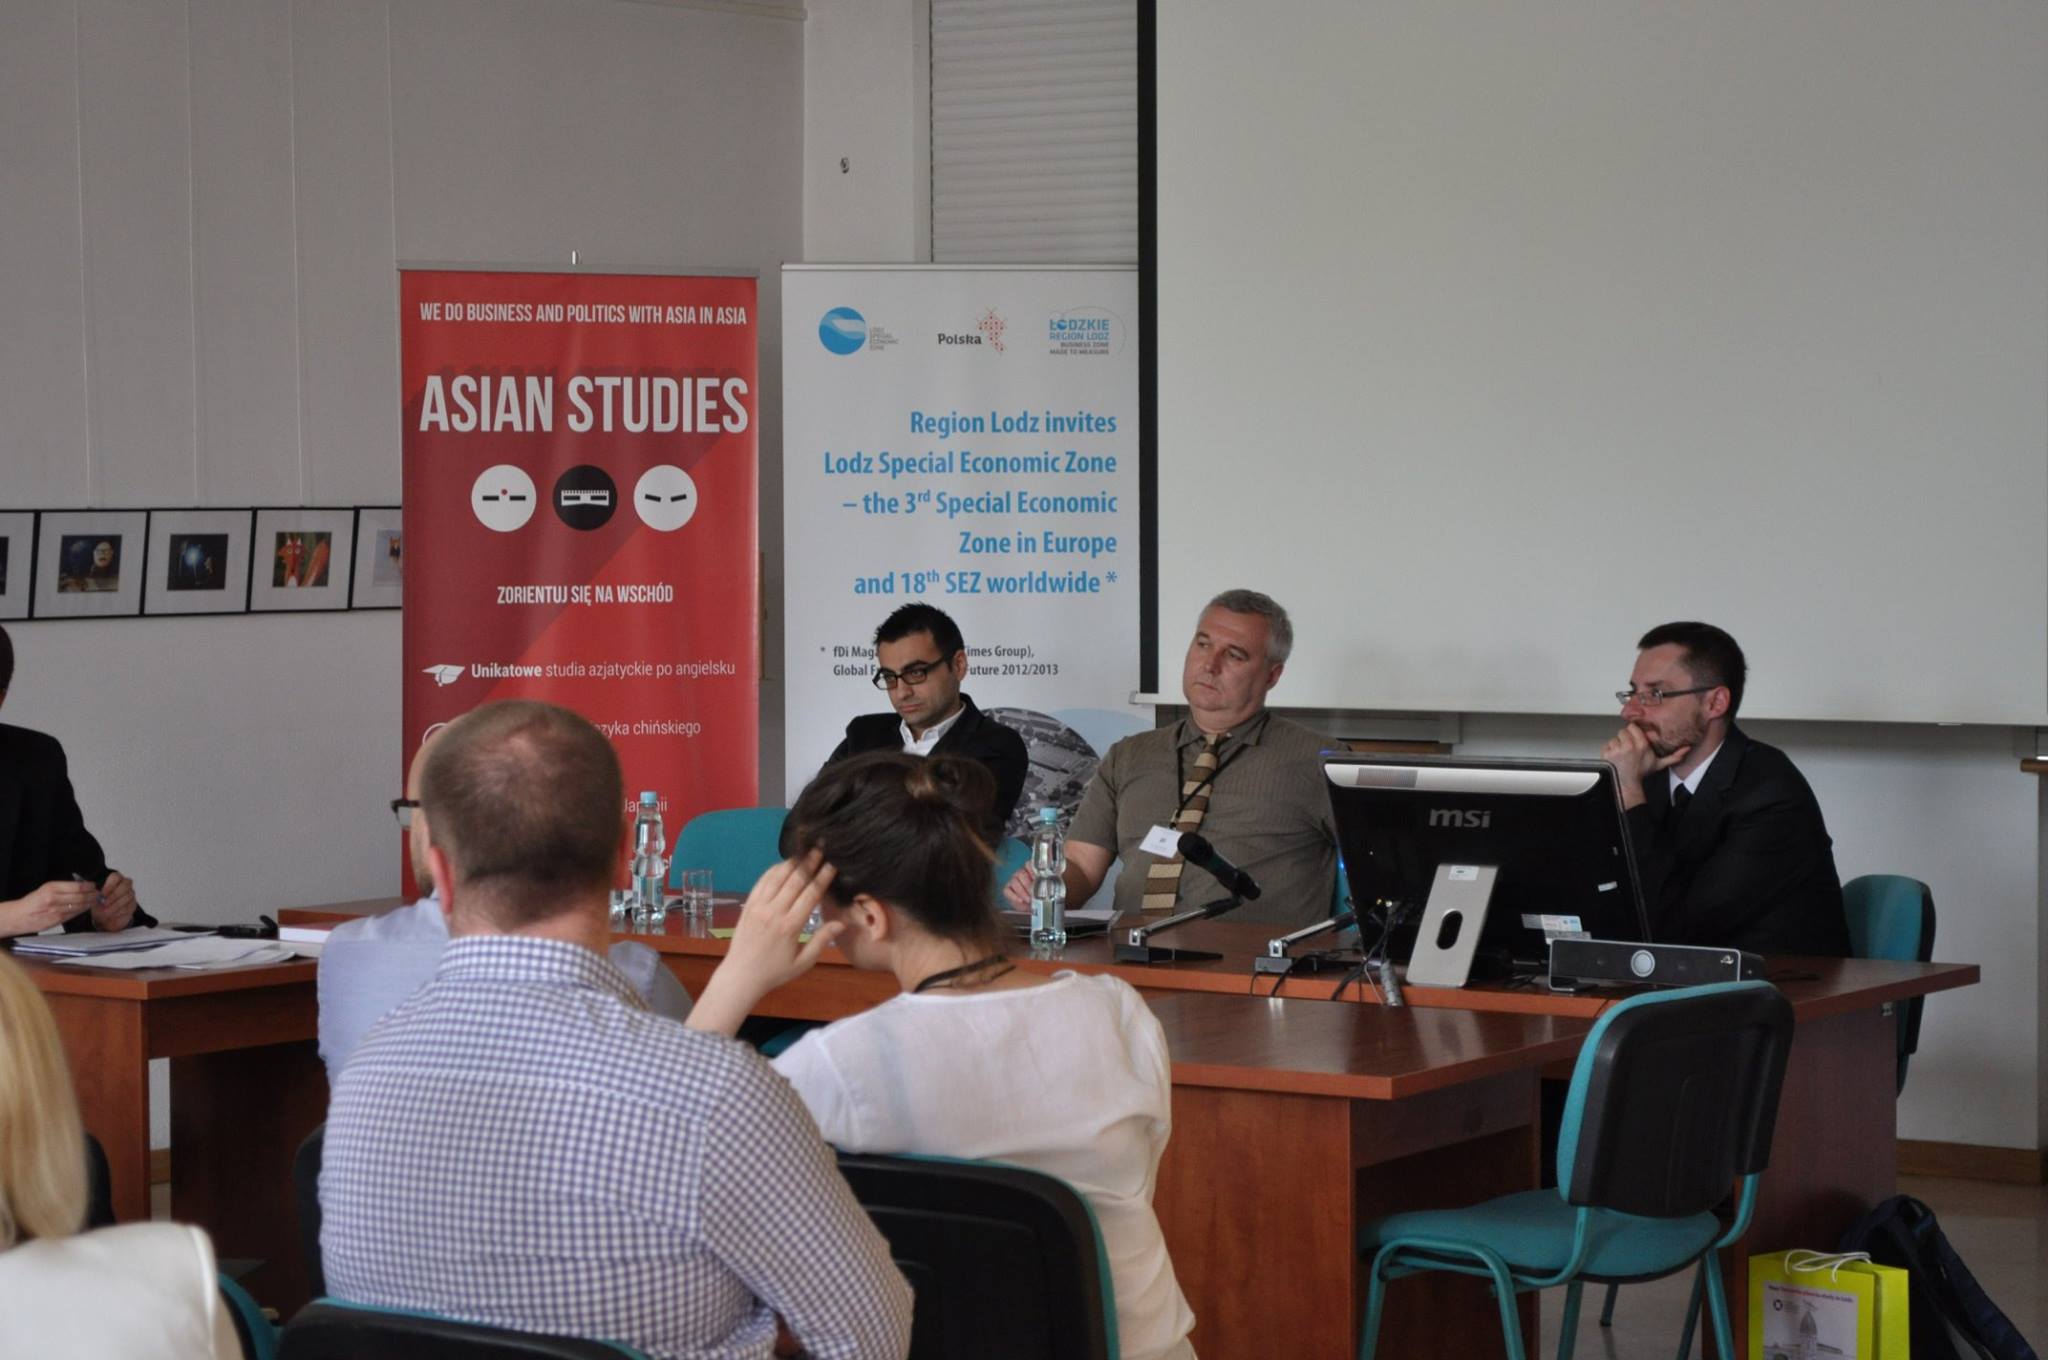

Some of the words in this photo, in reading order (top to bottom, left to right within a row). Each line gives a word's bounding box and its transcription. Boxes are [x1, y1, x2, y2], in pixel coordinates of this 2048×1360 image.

[420, 302, 442, 321] WE
[445, 303, 463, 321] DO
[467, 303, 532, 322] BUSINESS
[536, 304, 563, 322] AND
[567, 304, 625, 323] POLITICS
[629, 305, 662, 323] WITH
[666, 306, 697, 324] ASIA
[700, 306, 713, 324] IN
[716, 306, 747, 325] ASIA
[938, 333, 982, 345] Polska
[419, 375, 553, 433] ASIAN
[567, 376, 749, 434] STUDIES
[910, 411, 985, 439] Region
[991, 411, 1039, 433] Lodz
[1046, 411, 1117, 433] invites
[824, 451, 873, 474] Lodz
[879, 451, 953, 479] Special
[961, 451, 1060, 474] Economic
[1065, 451, 1117, 474] Zone
[863, 492, 899, 514] the
[936, 491, 1011, 519] Special
[1017, 491, 1118, 514] Economic
[959, 531, 1011, 554] Zone
[1017, 531, 1037, 553] in
[1043, 531, 1117, 558] Europe
[497, 585, 568, 605] ZORIENTUJ
[571, 585, 592, 606] SIĘ
[595, 585, 614, 603] NA
[617, 582, 674, 603] WSCHÓD
[854, 571, 894, 594] and
[945, 571, 981, 594] SEZ
[833, 646, 849, 658] fDi
[994, 645, 1034, 660] Group),
[471, 663, 542, 678] Unikatowe
[545, 662, 586, 678] studia
[589, 662, 652, 680] azjatyckie
[656, 664, 673, 680] po
[676, 660, 736, 678] angielsku
[833, 664, 868, 676] Global
[966, 664, 1000, 676] uture
[1002, 663, 1059, 676] 2012/2013
[633, 720, 702, 738] chińskiego
[1429, 808, 1492, 828] msi
